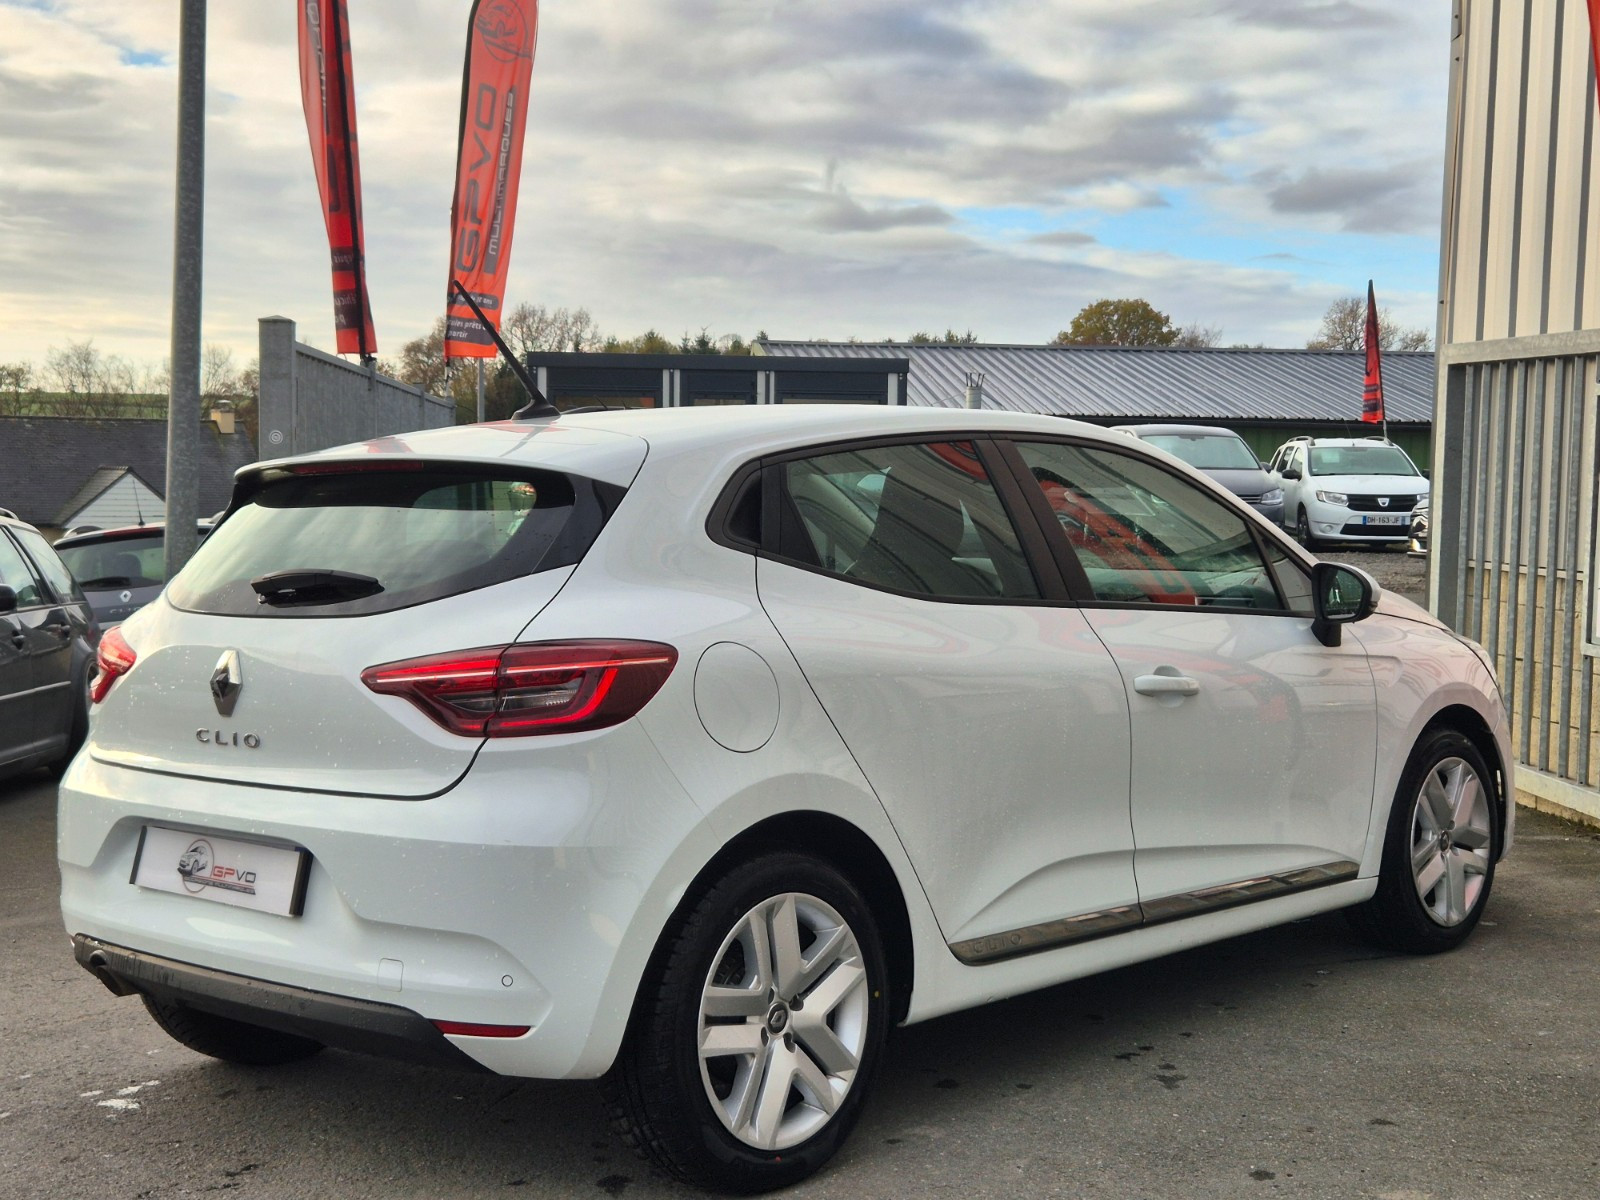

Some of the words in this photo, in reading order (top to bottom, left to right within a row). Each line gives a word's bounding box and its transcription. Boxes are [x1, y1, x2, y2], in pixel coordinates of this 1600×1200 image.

[456, 83, 497, 272] GPVO
[196, 728, 260, 748] CLIO
[213, 866, 256, 883] GPVO
